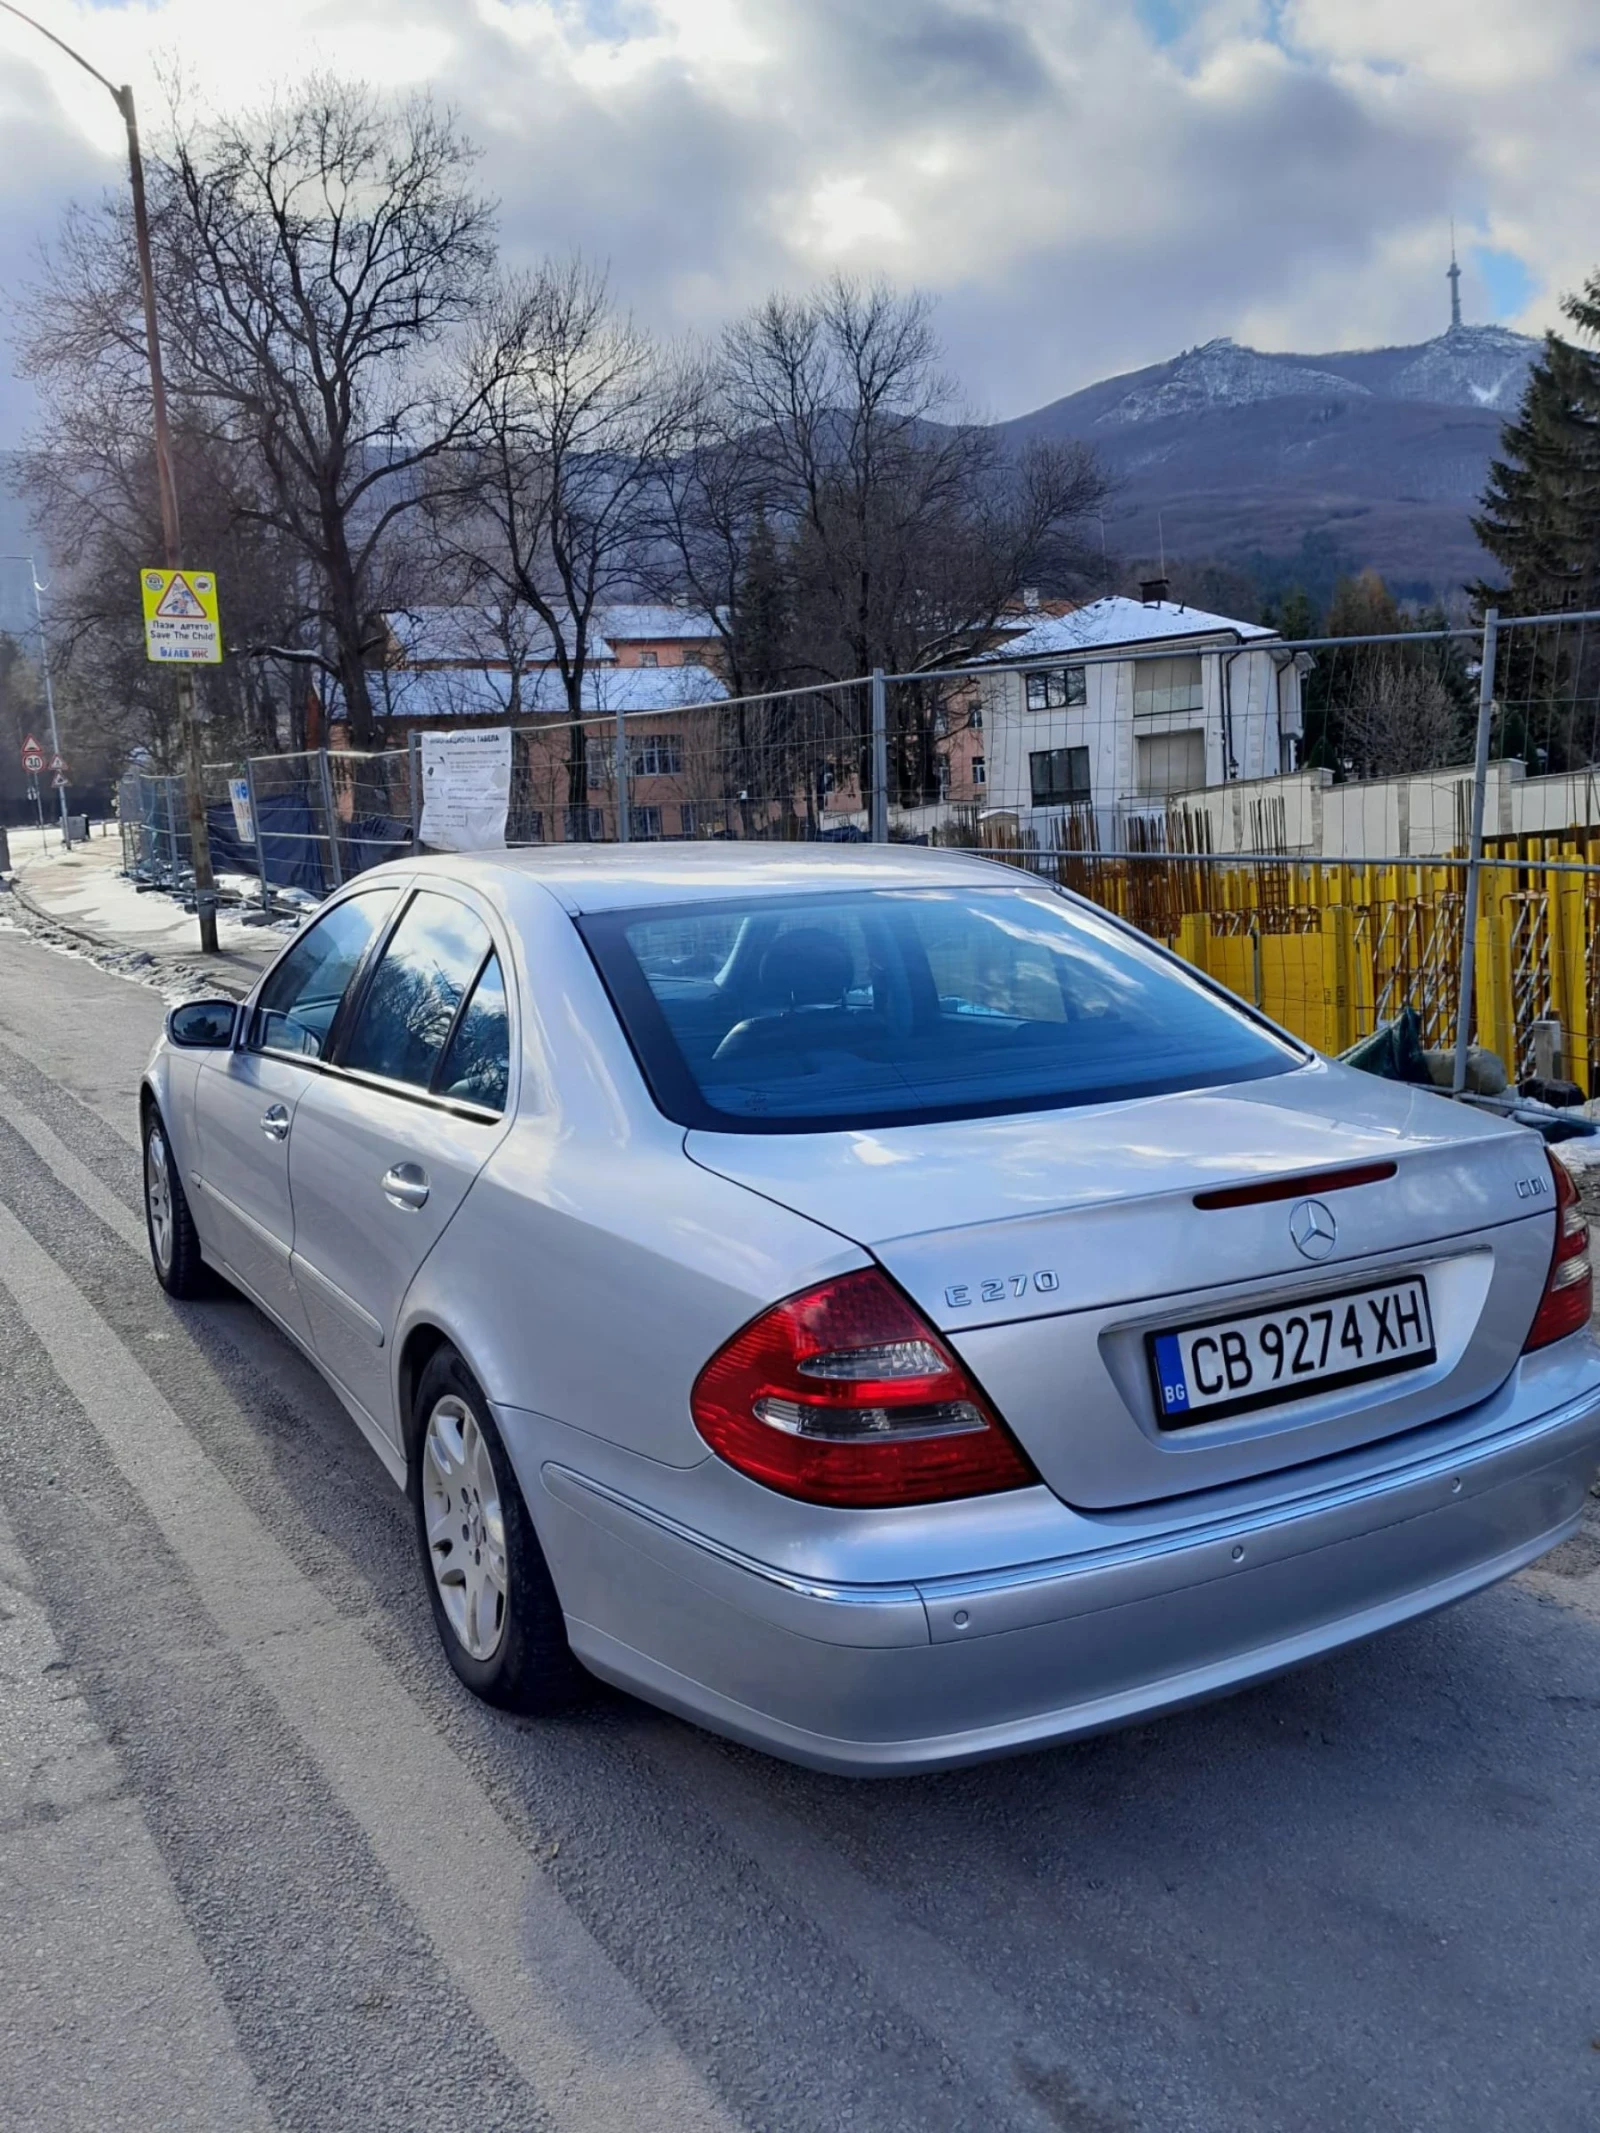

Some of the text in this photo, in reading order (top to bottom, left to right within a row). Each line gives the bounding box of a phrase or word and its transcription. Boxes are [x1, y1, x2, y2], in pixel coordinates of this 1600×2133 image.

[150, 630, 171, 639] Save
[173, 631, 189, 640] The
[152, 620, 175, 630] Пази
[28, 757, 41, 768] 30
[1514, 1175, 1548, 1199] CDI
[944, 1269, 1060, 1308] E 270
[1191, 1290, 1424, 1395] CB 9274 XH
[1164, 1383, 1186, 1404] BG
